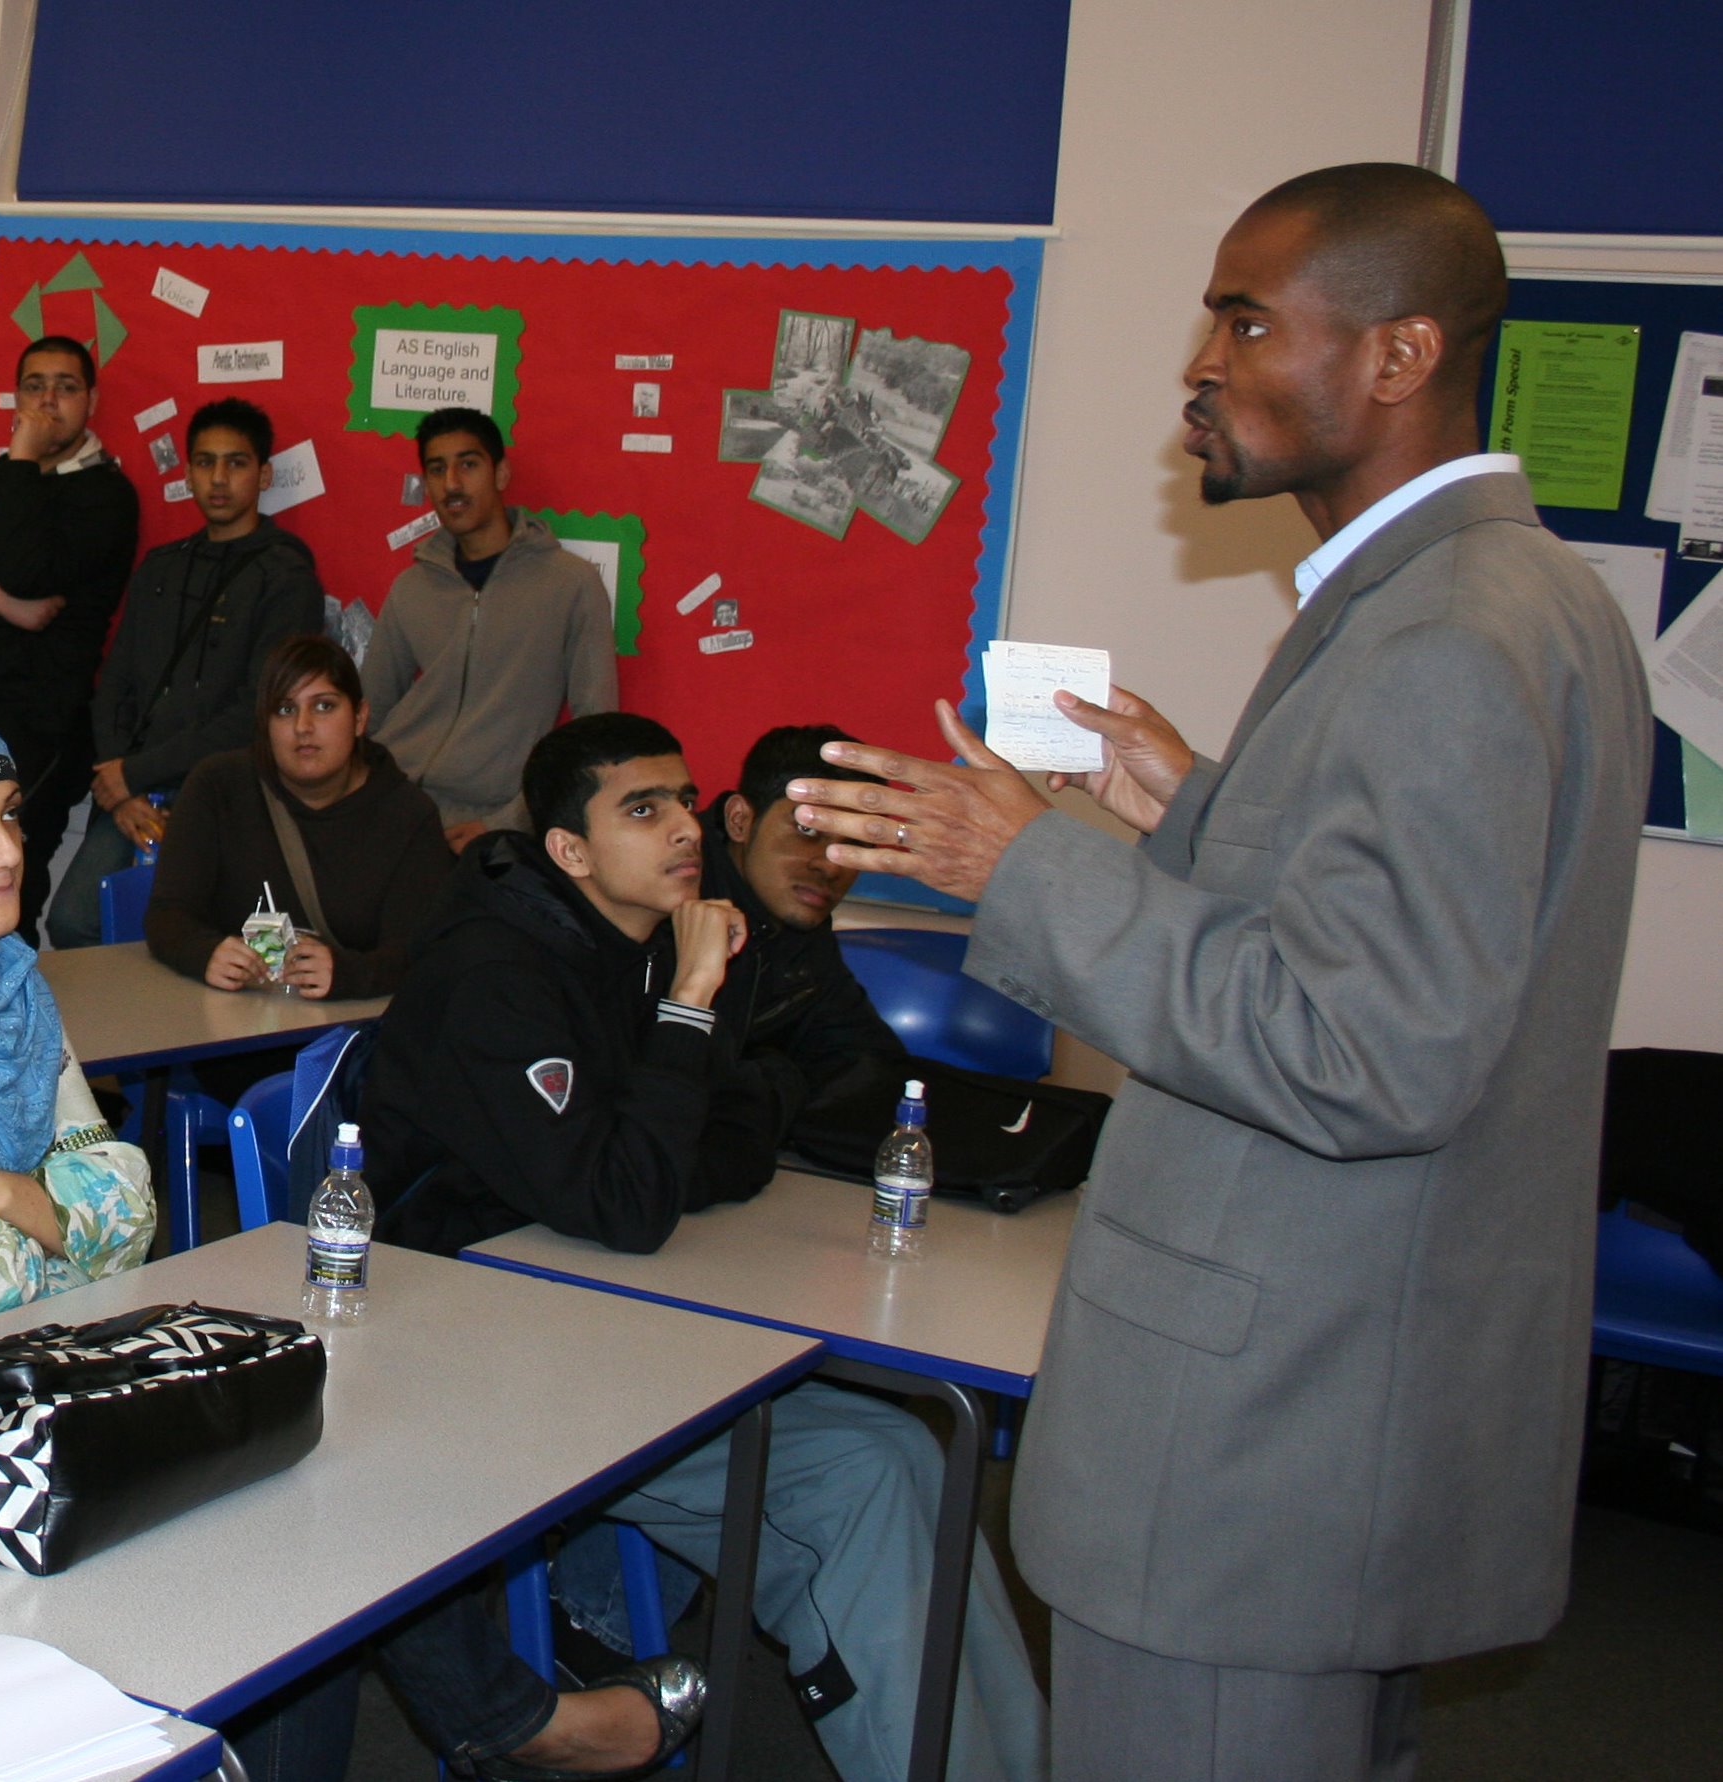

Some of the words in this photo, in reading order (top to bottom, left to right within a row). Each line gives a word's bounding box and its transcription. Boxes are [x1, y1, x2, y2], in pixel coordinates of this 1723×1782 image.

[159, 276, 195, 309] Voice
[233, 348, 271, 371] Techniques
[396, 338, 419, 354] AS
[423, 339, 480, 361] English
[381, 359, 456, 382] Language
[460, 366, 489, 381] and
[1506, 348, 1521, 397] Special
[1503, 399, 1517, 434] Form
